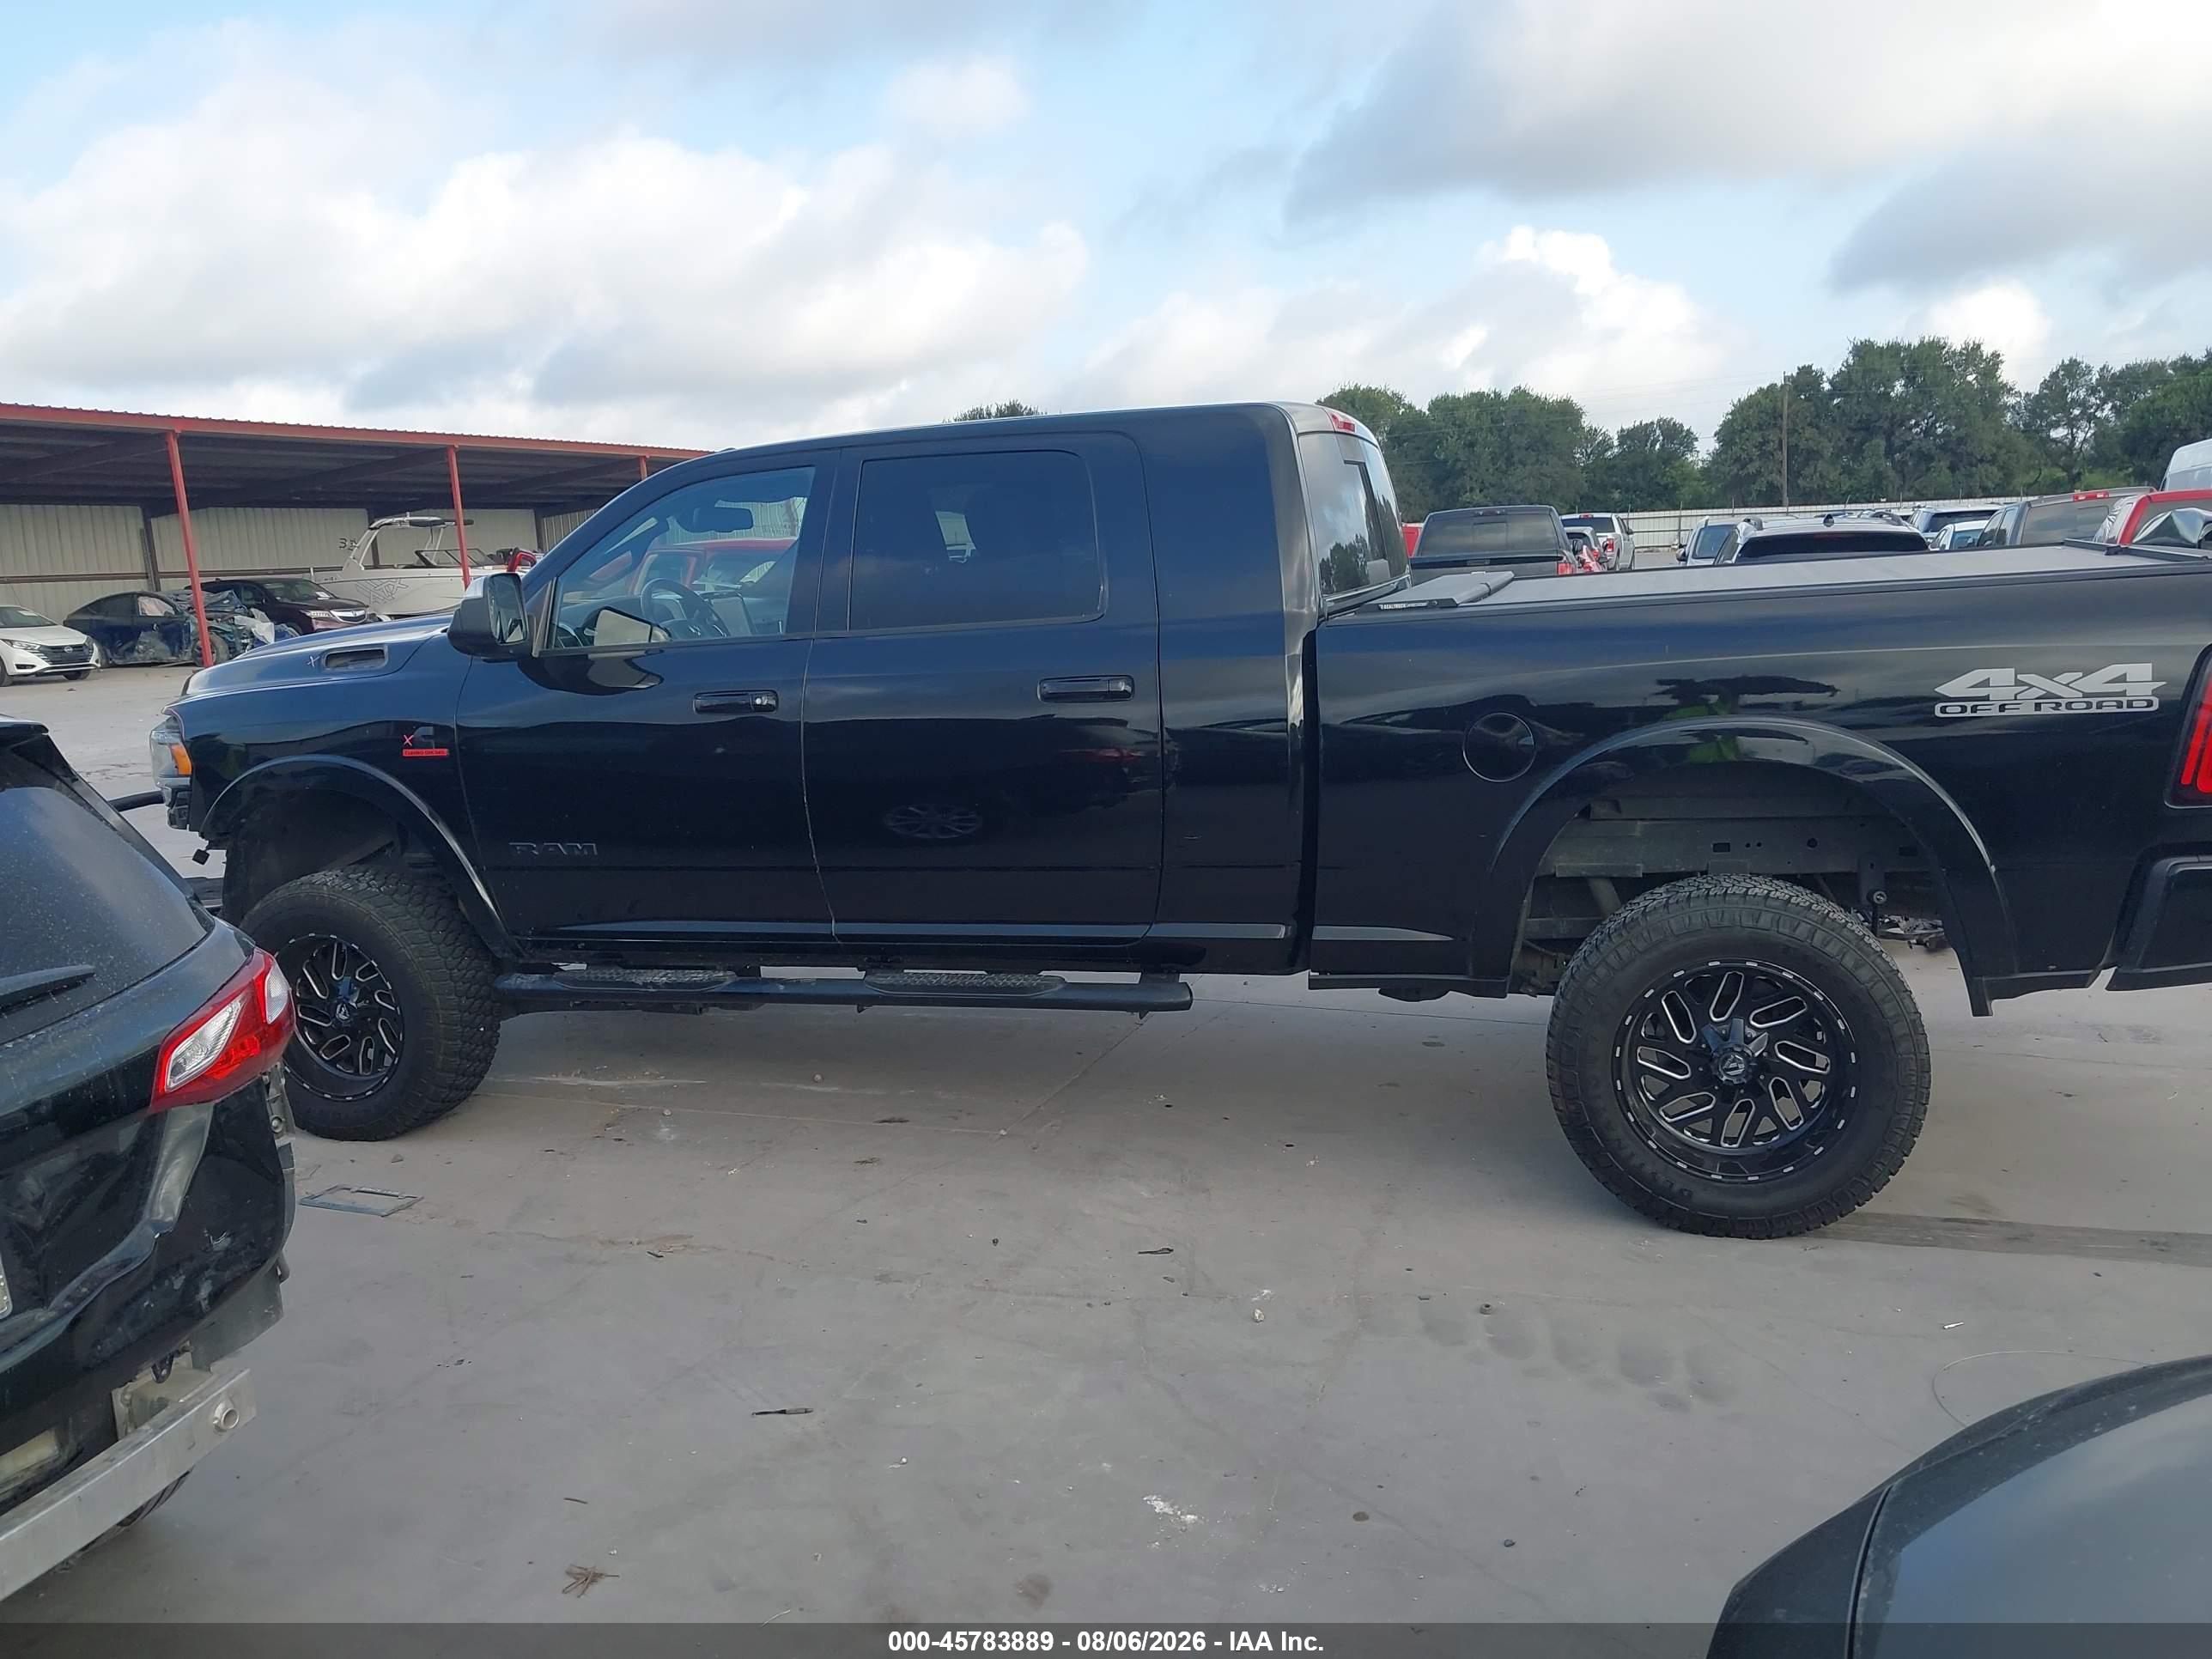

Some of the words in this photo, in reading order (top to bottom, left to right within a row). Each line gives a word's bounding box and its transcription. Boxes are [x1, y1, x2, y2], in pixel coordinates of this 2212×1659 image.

[1934, 662, 2167, 701] 4x4
[1939, 702, 2023, 714] OFF
[2033, 698, 2154, 713] ROAD
[508, 842, 599, 856] RAM
